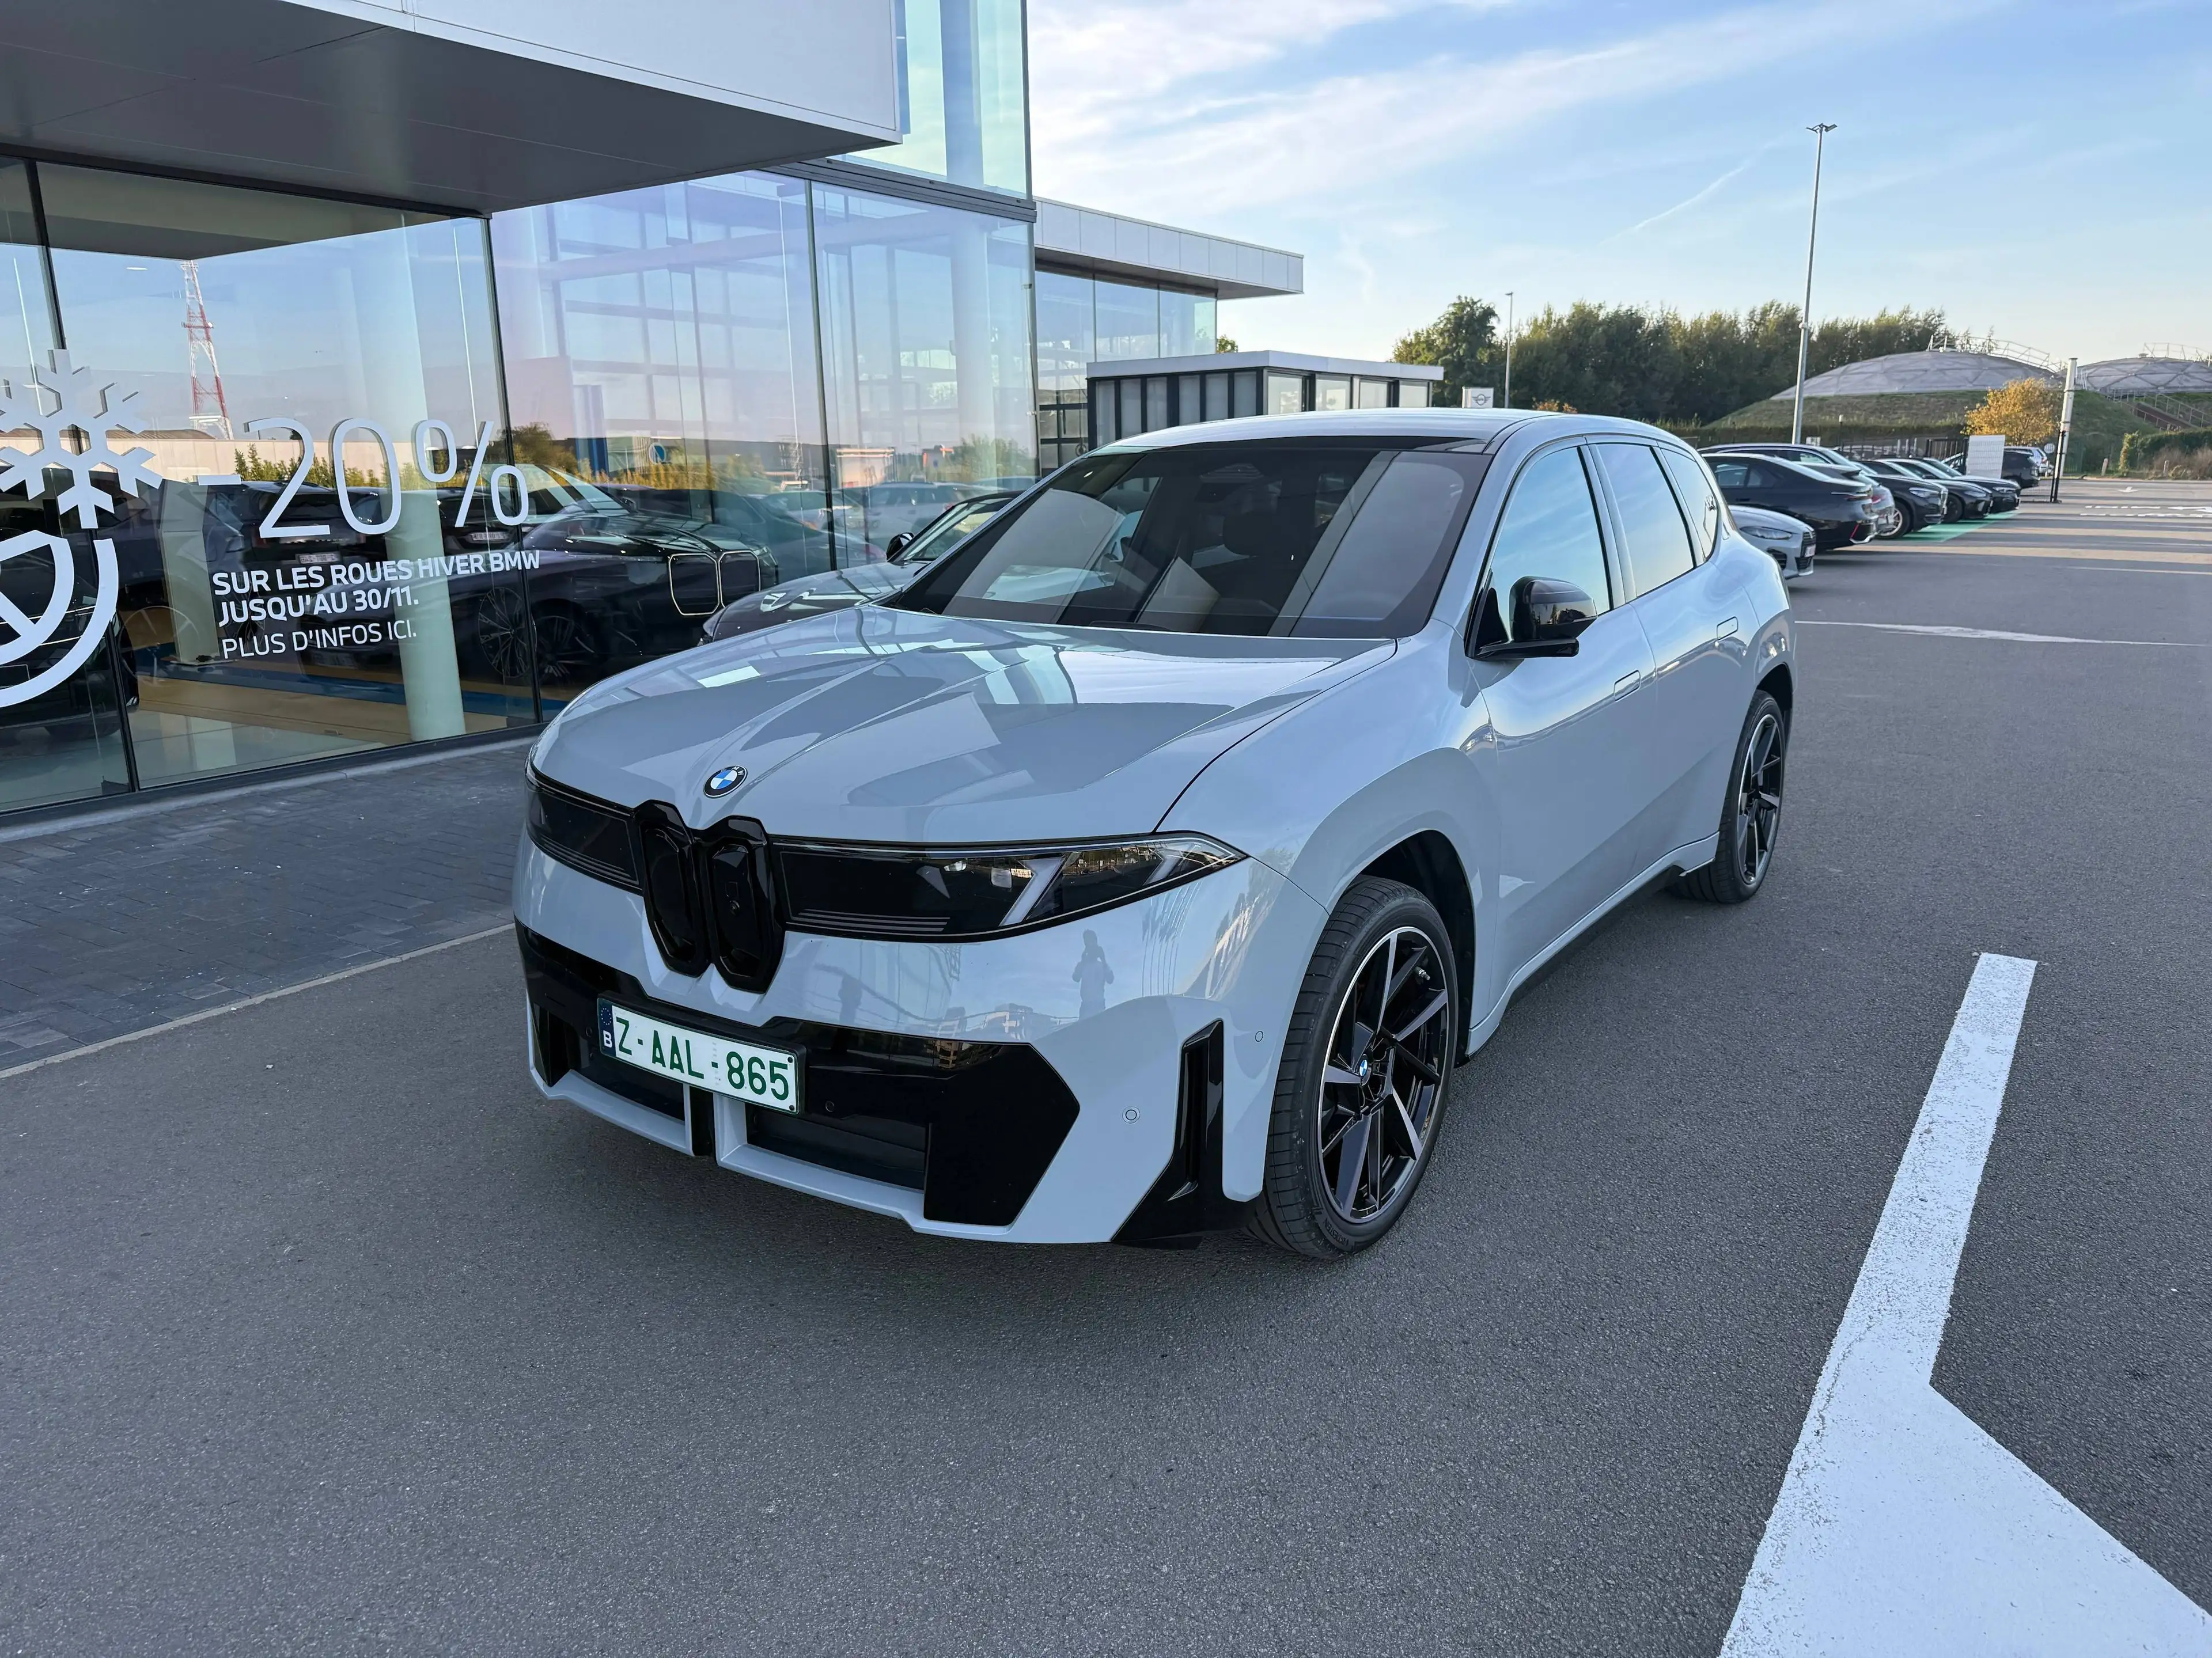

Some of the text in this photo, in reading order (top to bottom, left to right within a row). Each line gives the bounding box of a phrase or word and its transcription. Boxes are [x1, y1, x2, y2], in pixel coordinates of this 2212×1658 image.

[197, 418, 529, 538] -20%
[213, 550, 540, 595] SUR LES ROUES HIVER BMW
[219, 585, 419, 627] JUSQU'AU 30/11.
[222, 619, 417, 659] PLUS D'INFOS ICI.
[603, 1030, 613, 1048] B
[616, 1016, 789, 1101] Z-AAL-865
